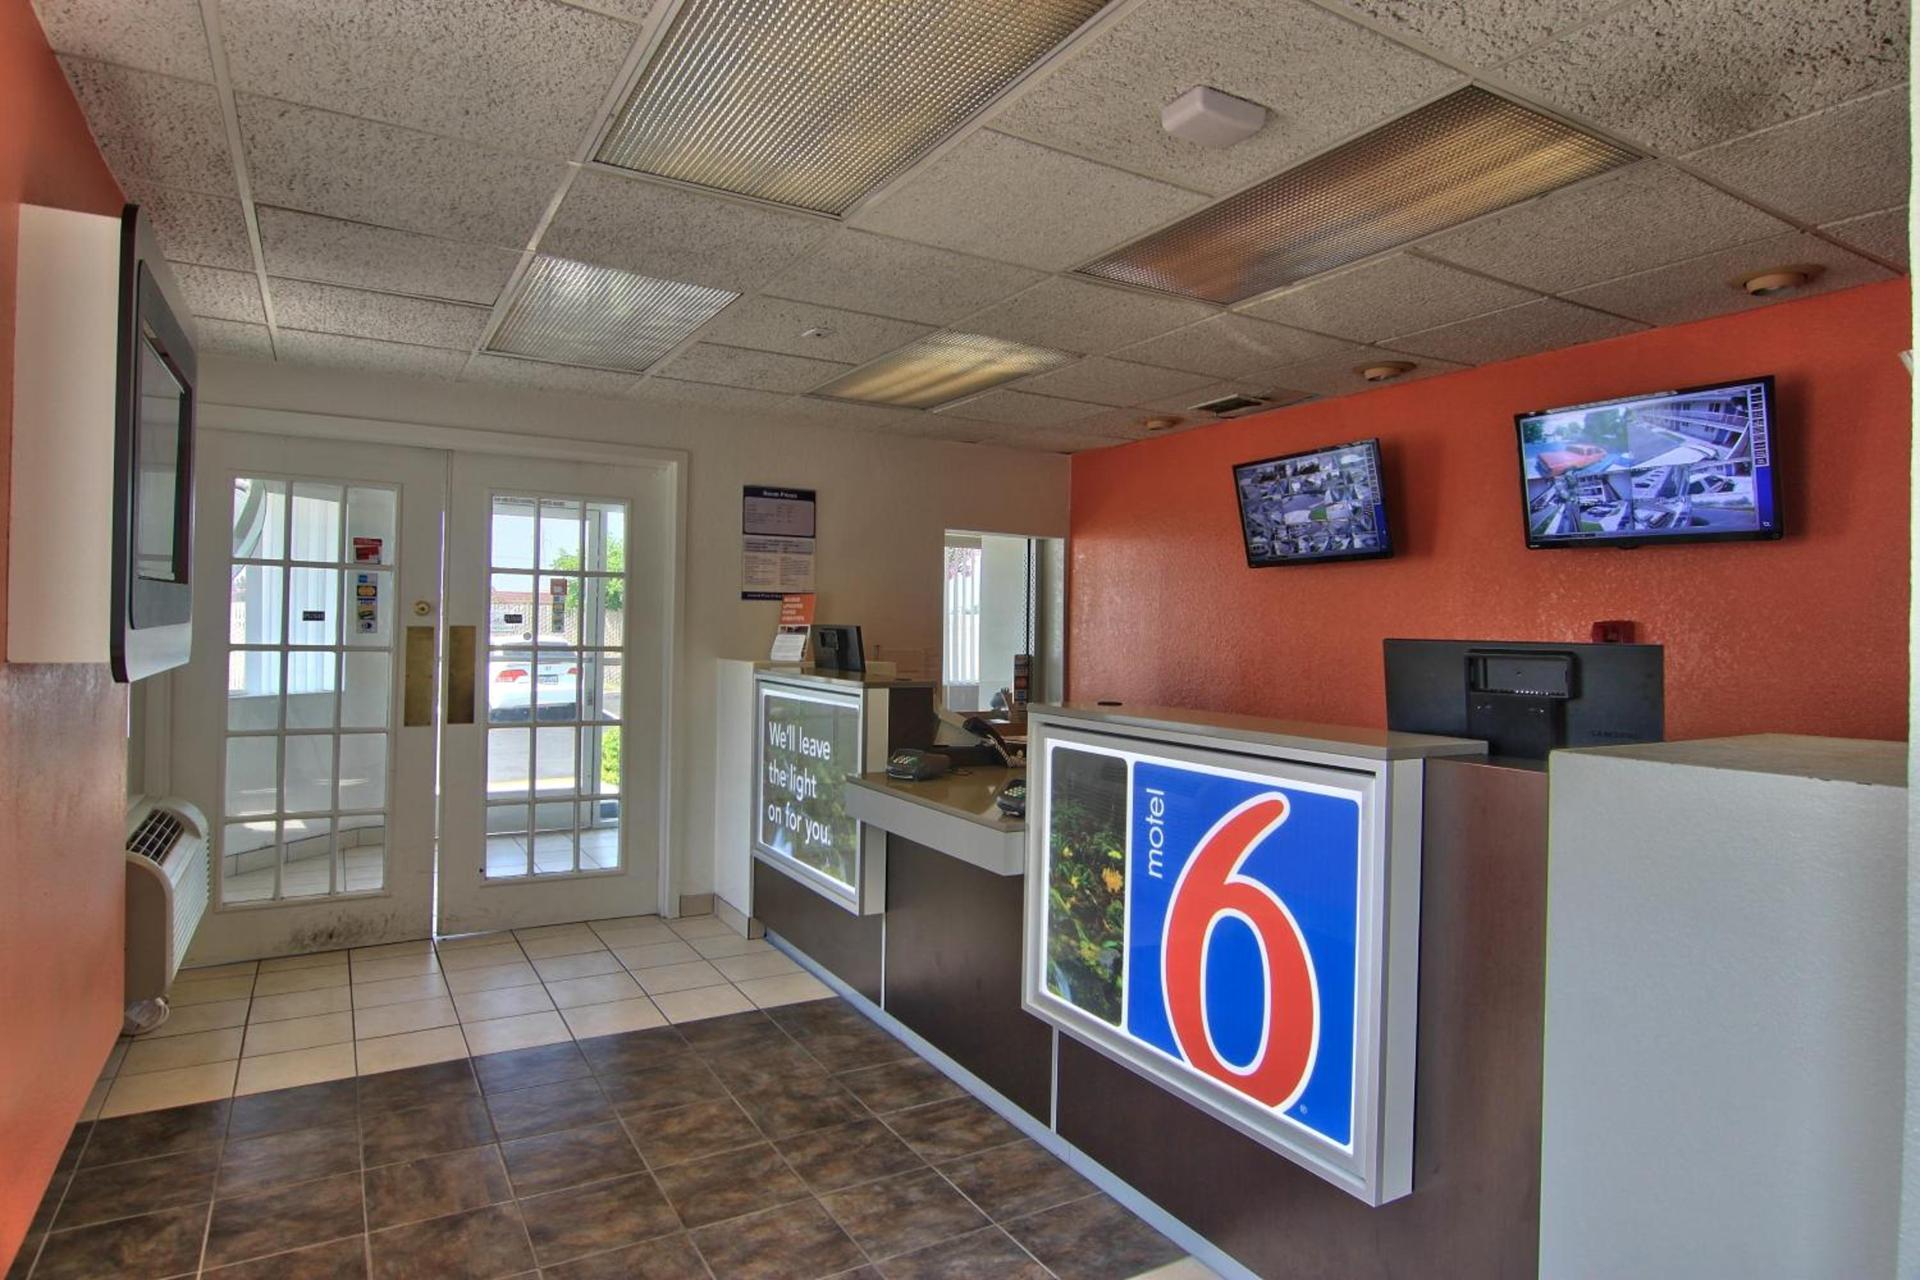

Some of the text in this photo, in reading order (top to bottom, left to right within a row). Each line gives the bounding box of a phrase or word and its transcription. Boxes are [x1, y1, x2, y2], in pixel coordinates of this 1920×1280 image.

[768, 722, 831, 760] We'll leave
[768, 759, 818, 802] the light
[768, 802, 831, 846] on for you.
[1145, 787, 1165, 879] motel
[1161, 791, 1320, 1112] 6
